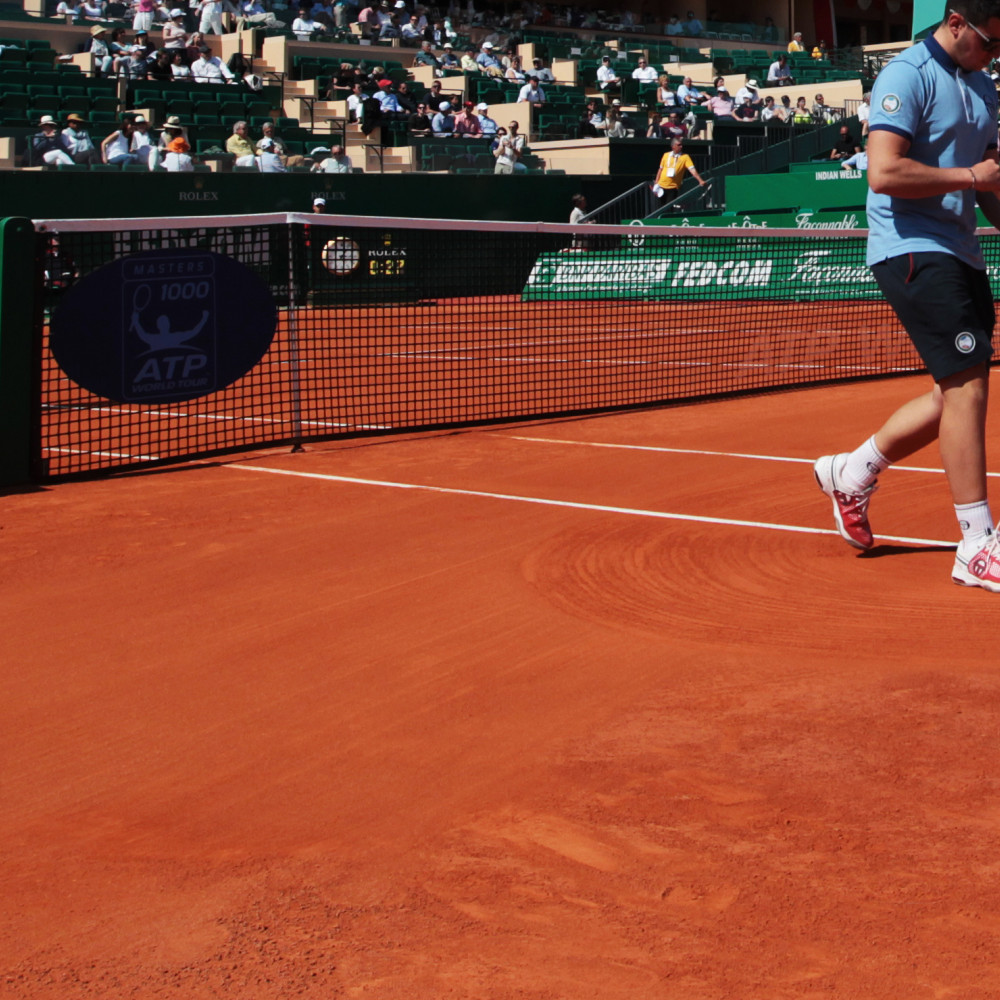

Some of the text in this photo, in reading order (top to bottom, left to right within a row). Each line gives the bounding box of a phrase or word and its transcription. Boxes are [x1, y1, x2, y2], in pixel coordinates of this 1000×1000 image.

[815, 169, 863, 180] INDIAN WELLS
[178, 191, 219, 201] ROLEX
[311, 191, 346, 201] ROLEX
[133, 261, 205, 276] MASTERS
[160, 280, 210, 301] 1000
[132, 353, 208, 384] ATP
[131, 377, 209, 394] WORLD TOUR
